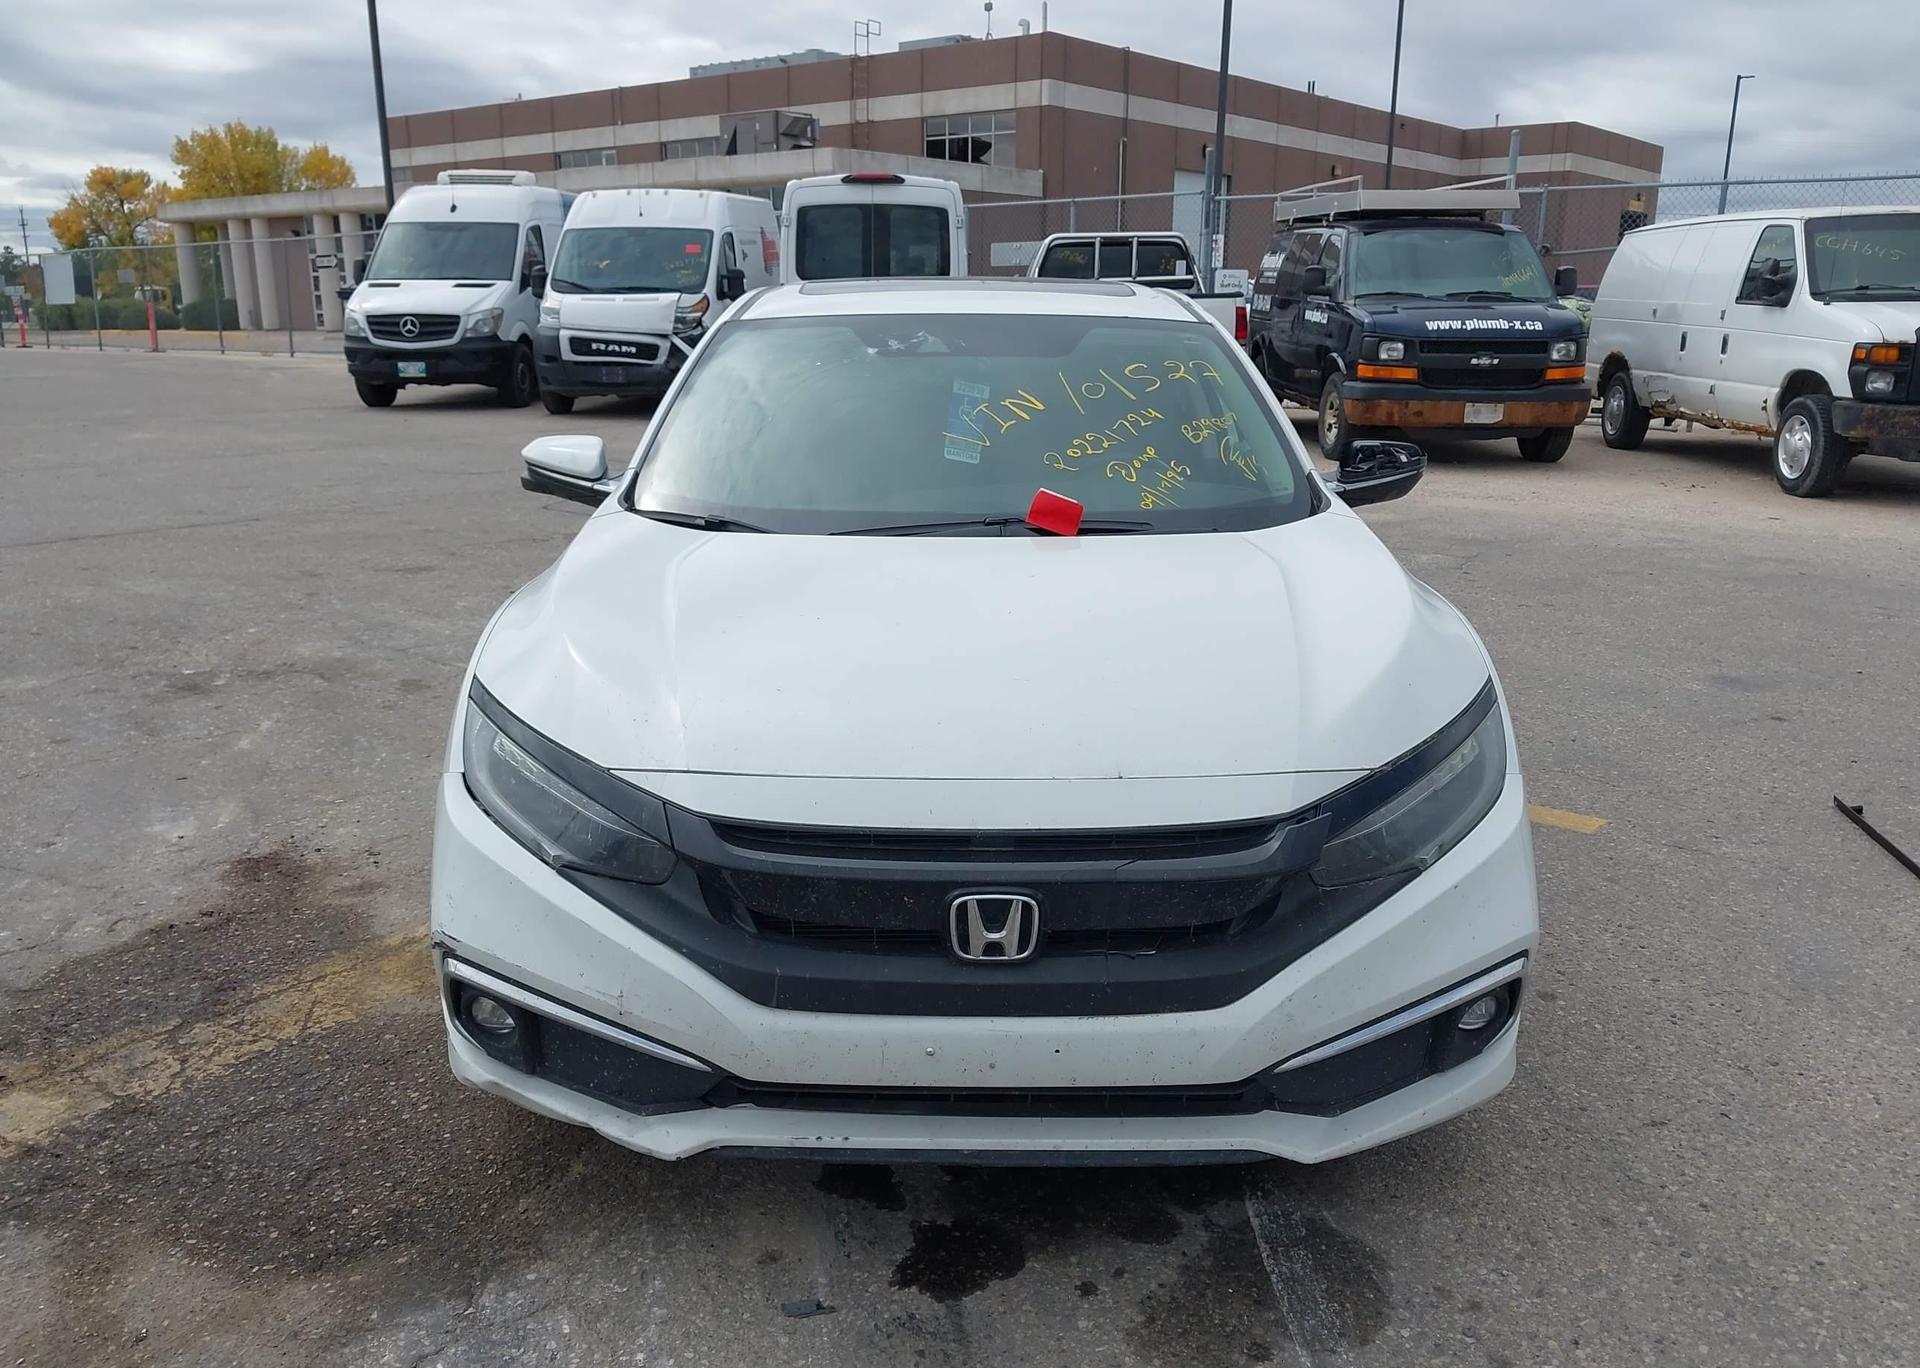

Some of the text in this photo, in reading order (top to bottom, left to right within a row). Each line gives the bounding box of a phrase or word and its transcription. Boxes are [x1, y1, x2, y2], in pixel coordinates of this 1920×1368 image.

[1425, 318, 1543, 331] www.plumb-x.ca
[592, 343, 637, 354] RAM
[942, 389, 1045, 446] VIN
